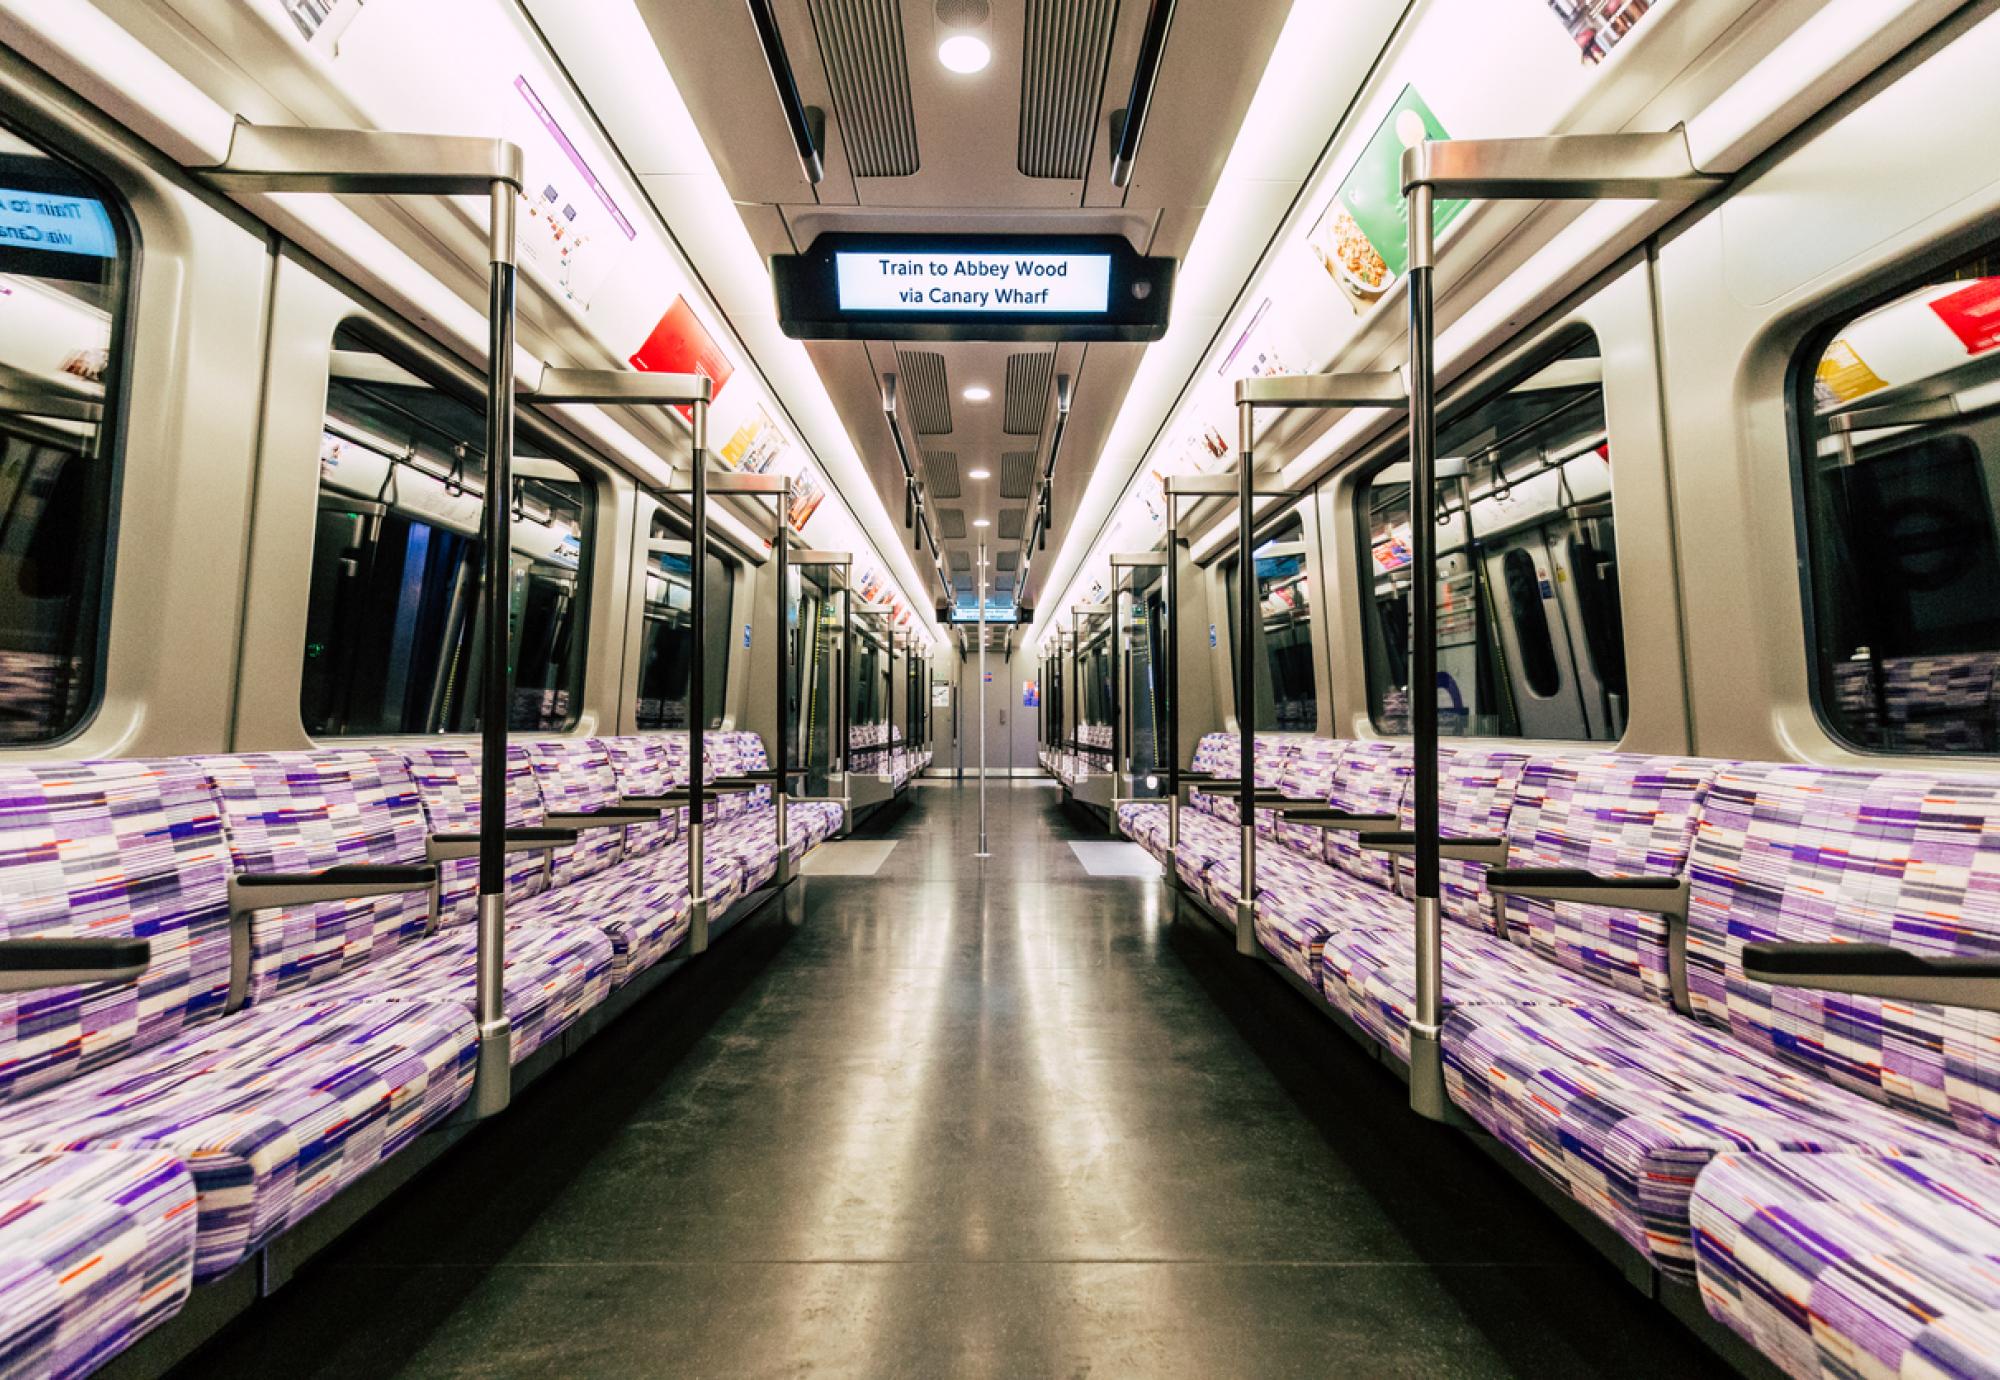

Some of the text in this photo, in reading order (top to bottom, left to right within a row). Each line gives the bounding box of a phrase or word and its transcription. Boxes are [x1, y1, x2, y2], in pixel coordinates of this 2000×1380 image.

[879, 259, 1067, 279] Train to Abbey Wood
[899, 288, 1049, 307] via Canary Wharf
